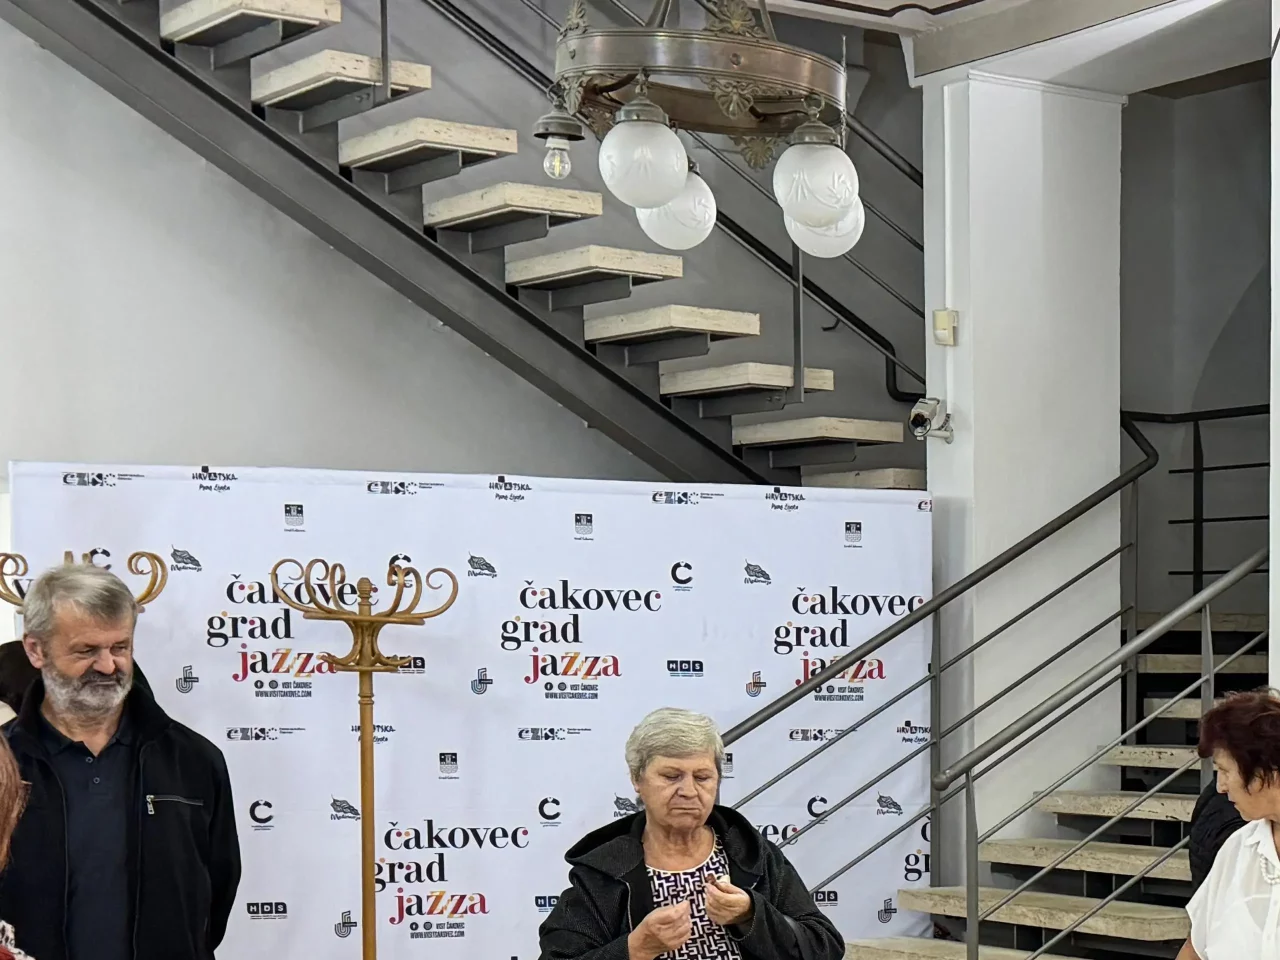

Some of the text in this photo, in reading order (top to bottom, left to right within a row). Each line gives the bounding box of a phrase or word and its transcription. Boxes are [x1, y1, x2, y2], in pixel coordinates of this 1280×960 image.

[519, 579, 662, 611] čakovec
[206, 608, 295, 648] grad
[500, 614, 583, 651] grad
[773, 618, 850, 655] grad
[523, 646, 622, 684] jazza
[667, 660, 704, 672] HDS
[384, 819, 530, 851] čakovec
[247, 902, 287, 914] HDS
[388, 887, 491, 925] jazza
